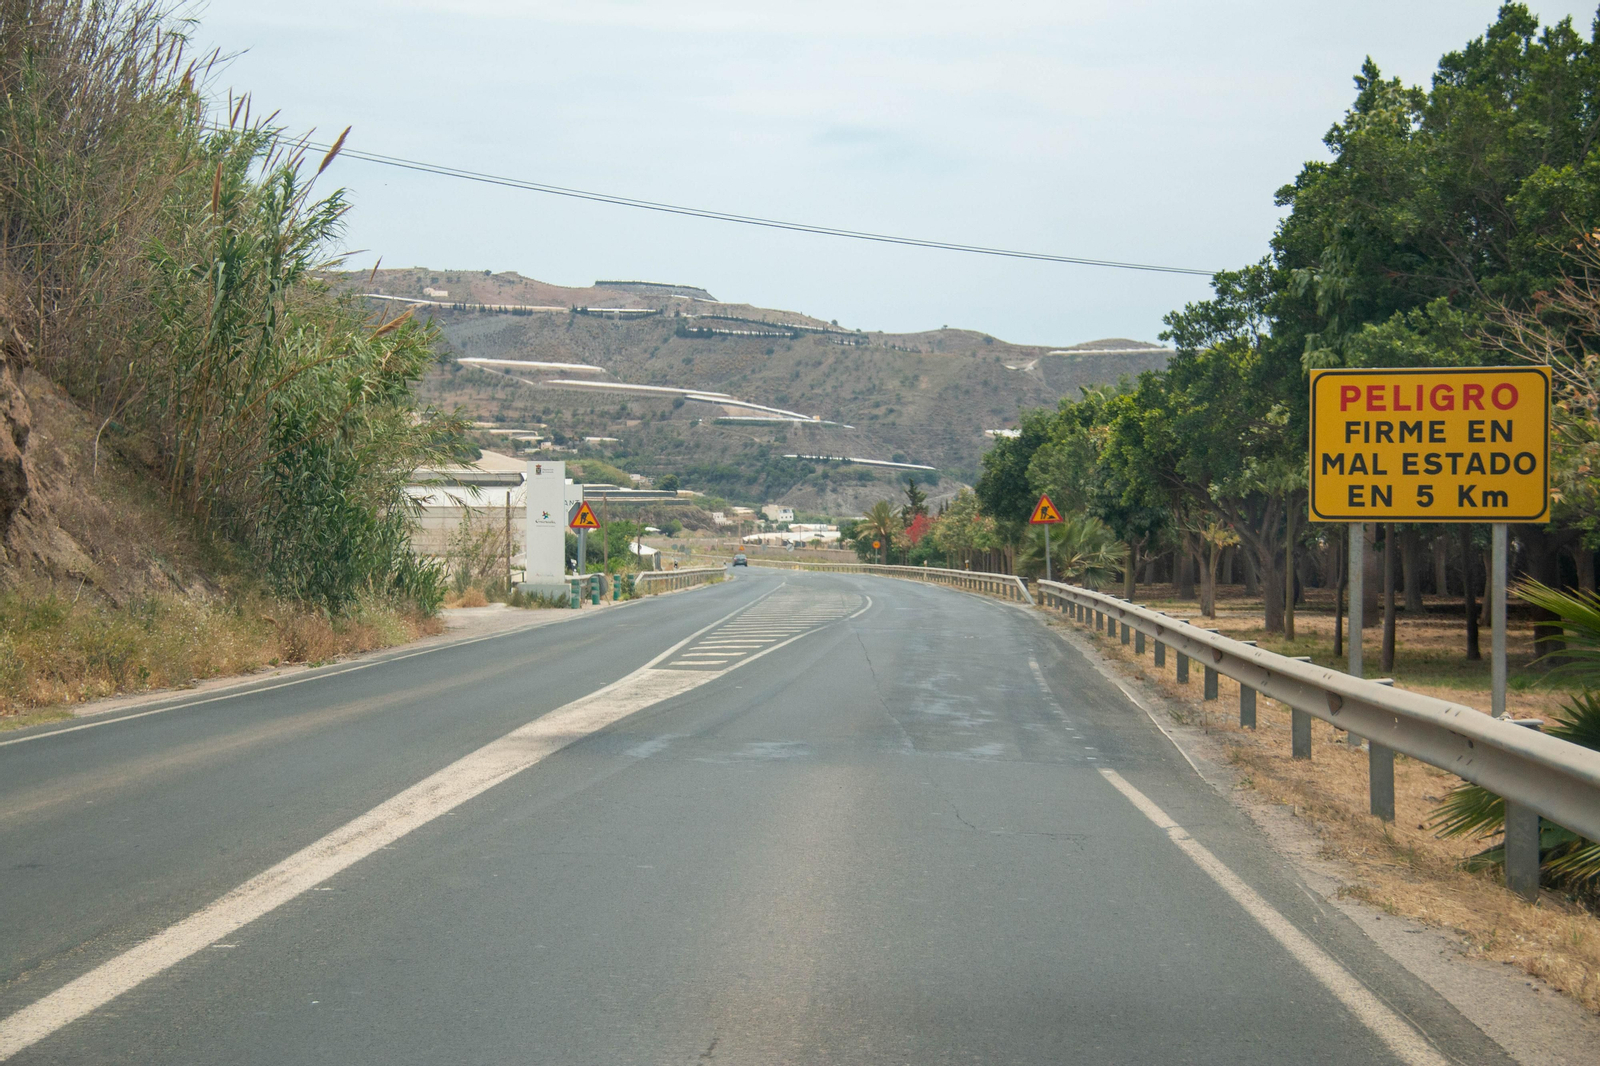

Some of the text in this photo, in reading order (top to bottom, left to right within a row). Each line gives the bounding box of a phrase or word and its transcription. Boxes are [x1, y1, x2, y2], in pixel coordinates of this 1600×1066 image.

[1340, 383, 1519, 411] PELIGRO
[1345, 419, 1513, 443] FIRME EN
[1322, 452, 1537, 476] MAL ESTADO
[1348, 485, 1509, 508] EN 5 Km
